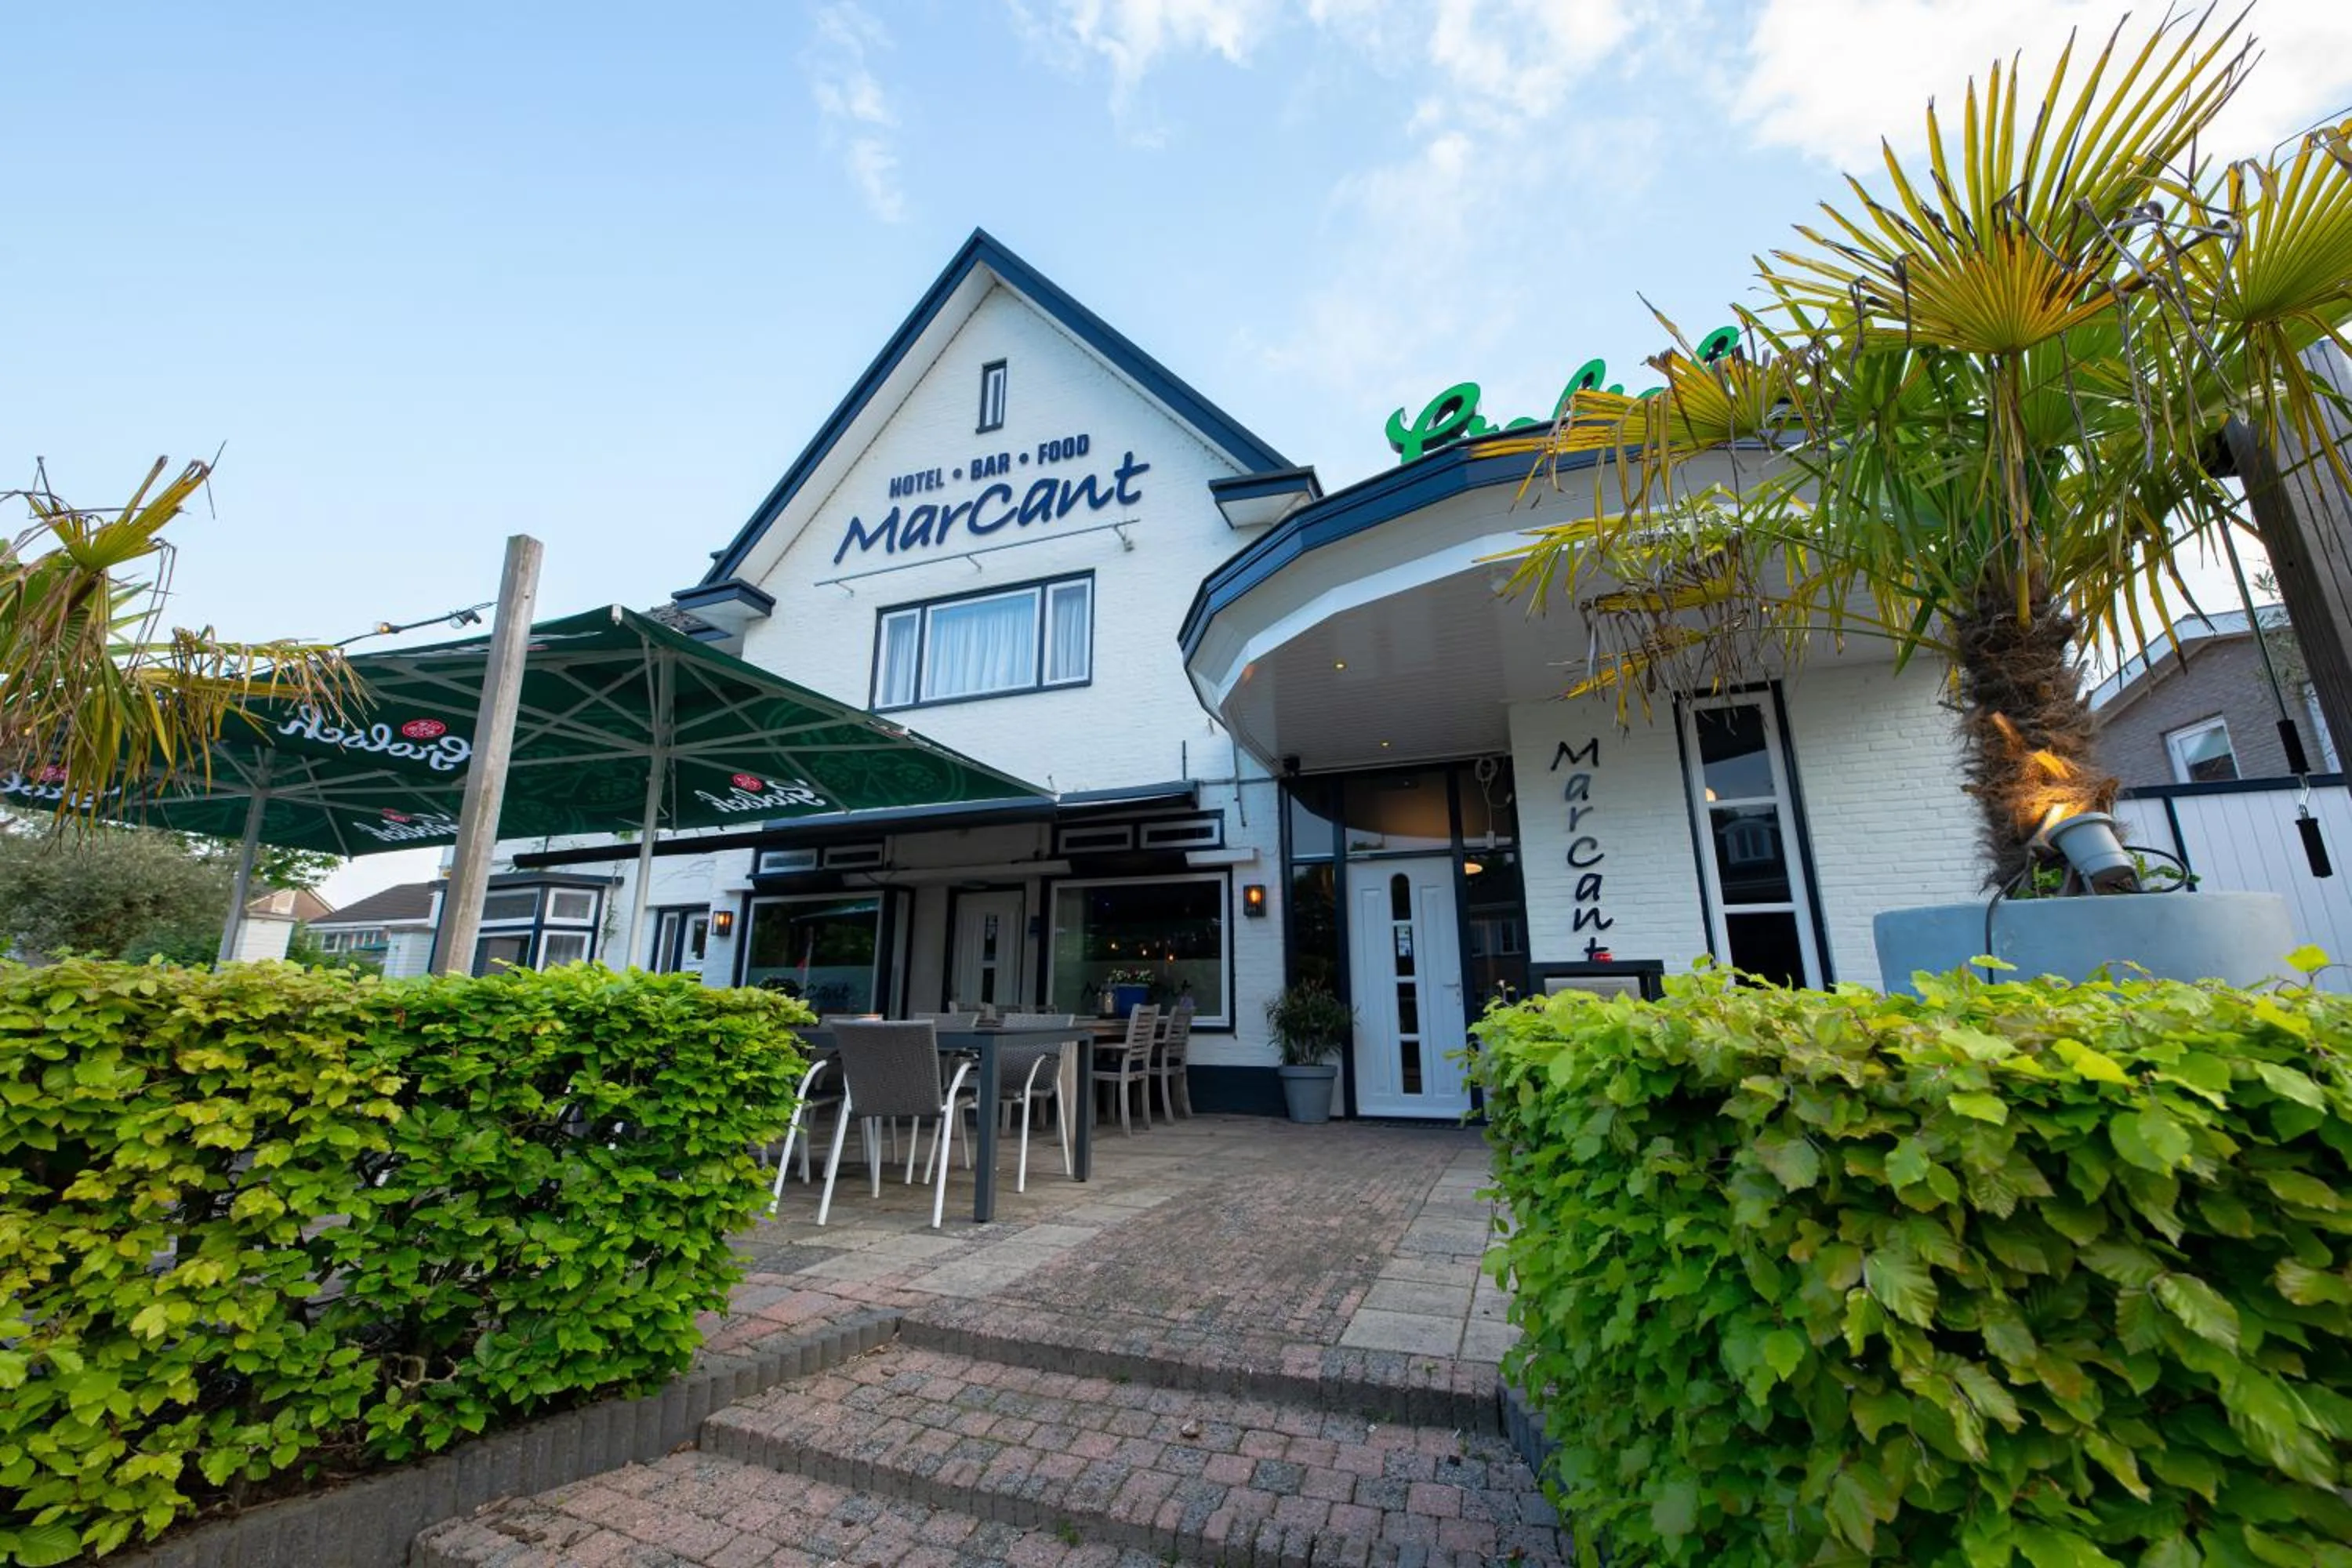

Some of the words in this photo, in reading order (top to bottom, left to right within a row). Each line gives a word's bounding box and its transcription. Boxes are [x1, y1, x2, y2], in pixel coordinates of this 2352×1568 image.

[889, 468, 945, 499] HOTEL
[970, 452, 1011, 481] BAR
[1037, 434, 1089, 465] FOOD
